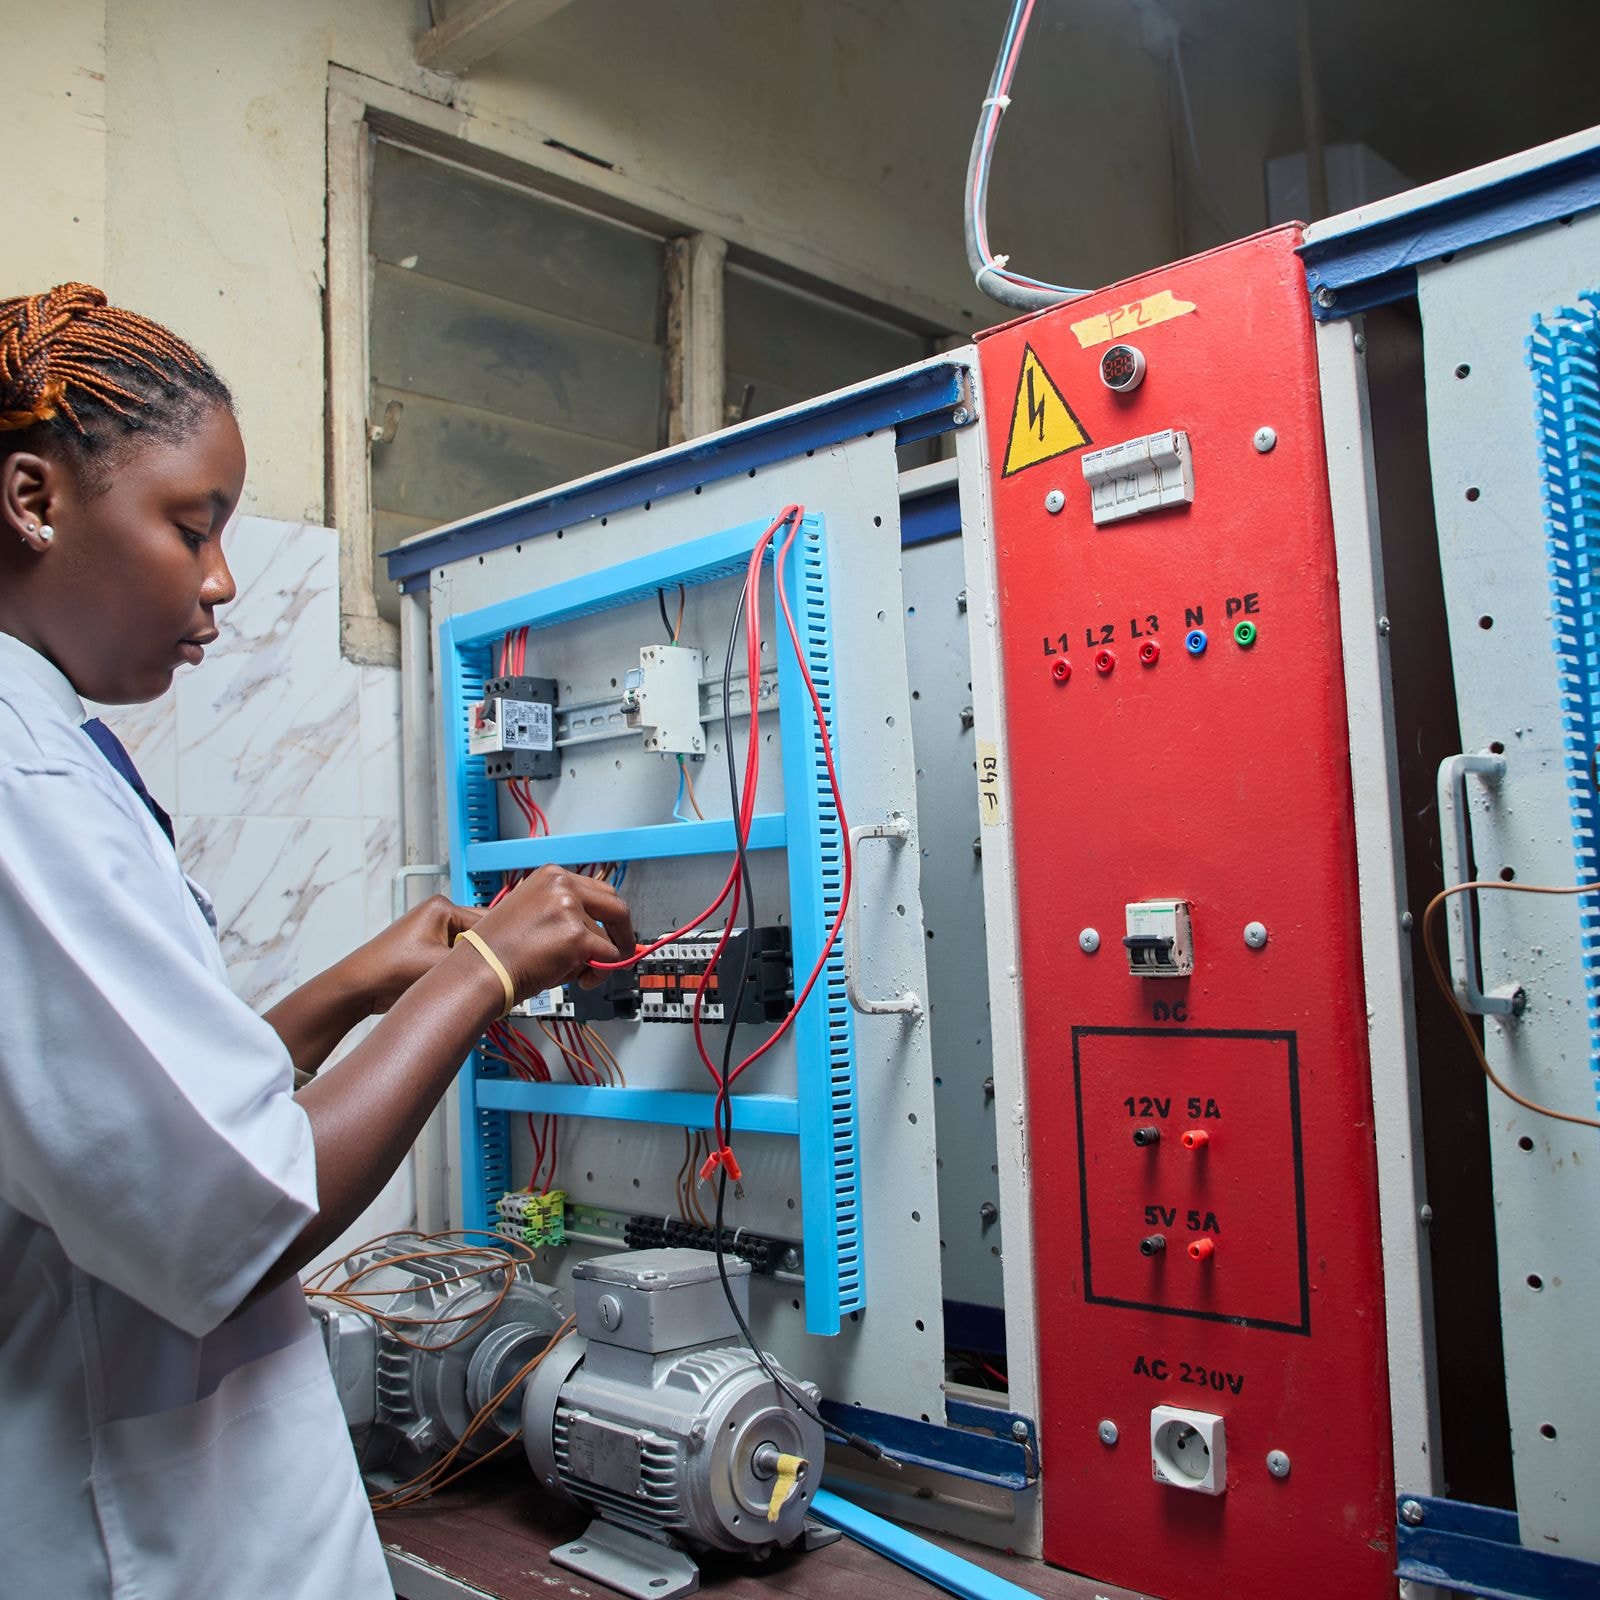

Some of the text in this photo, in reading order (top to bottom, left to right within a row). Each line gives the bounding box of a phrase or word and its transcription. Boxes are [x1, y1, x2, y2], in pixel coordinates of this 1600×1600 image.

[1102, 302, 1152, 338] P2
[1043, 593, 1260, 656] L1 L2 L3 N PE
[980, 757, 998, 783] B4
[1152, 999, 1187, 1022] DC
[1124, 1096, 1221, 1118] 12V 5A
[1144, 1205, 1220, 1233] 5V 5A
[1133, 1355, 1245, 1395] AC 230V
